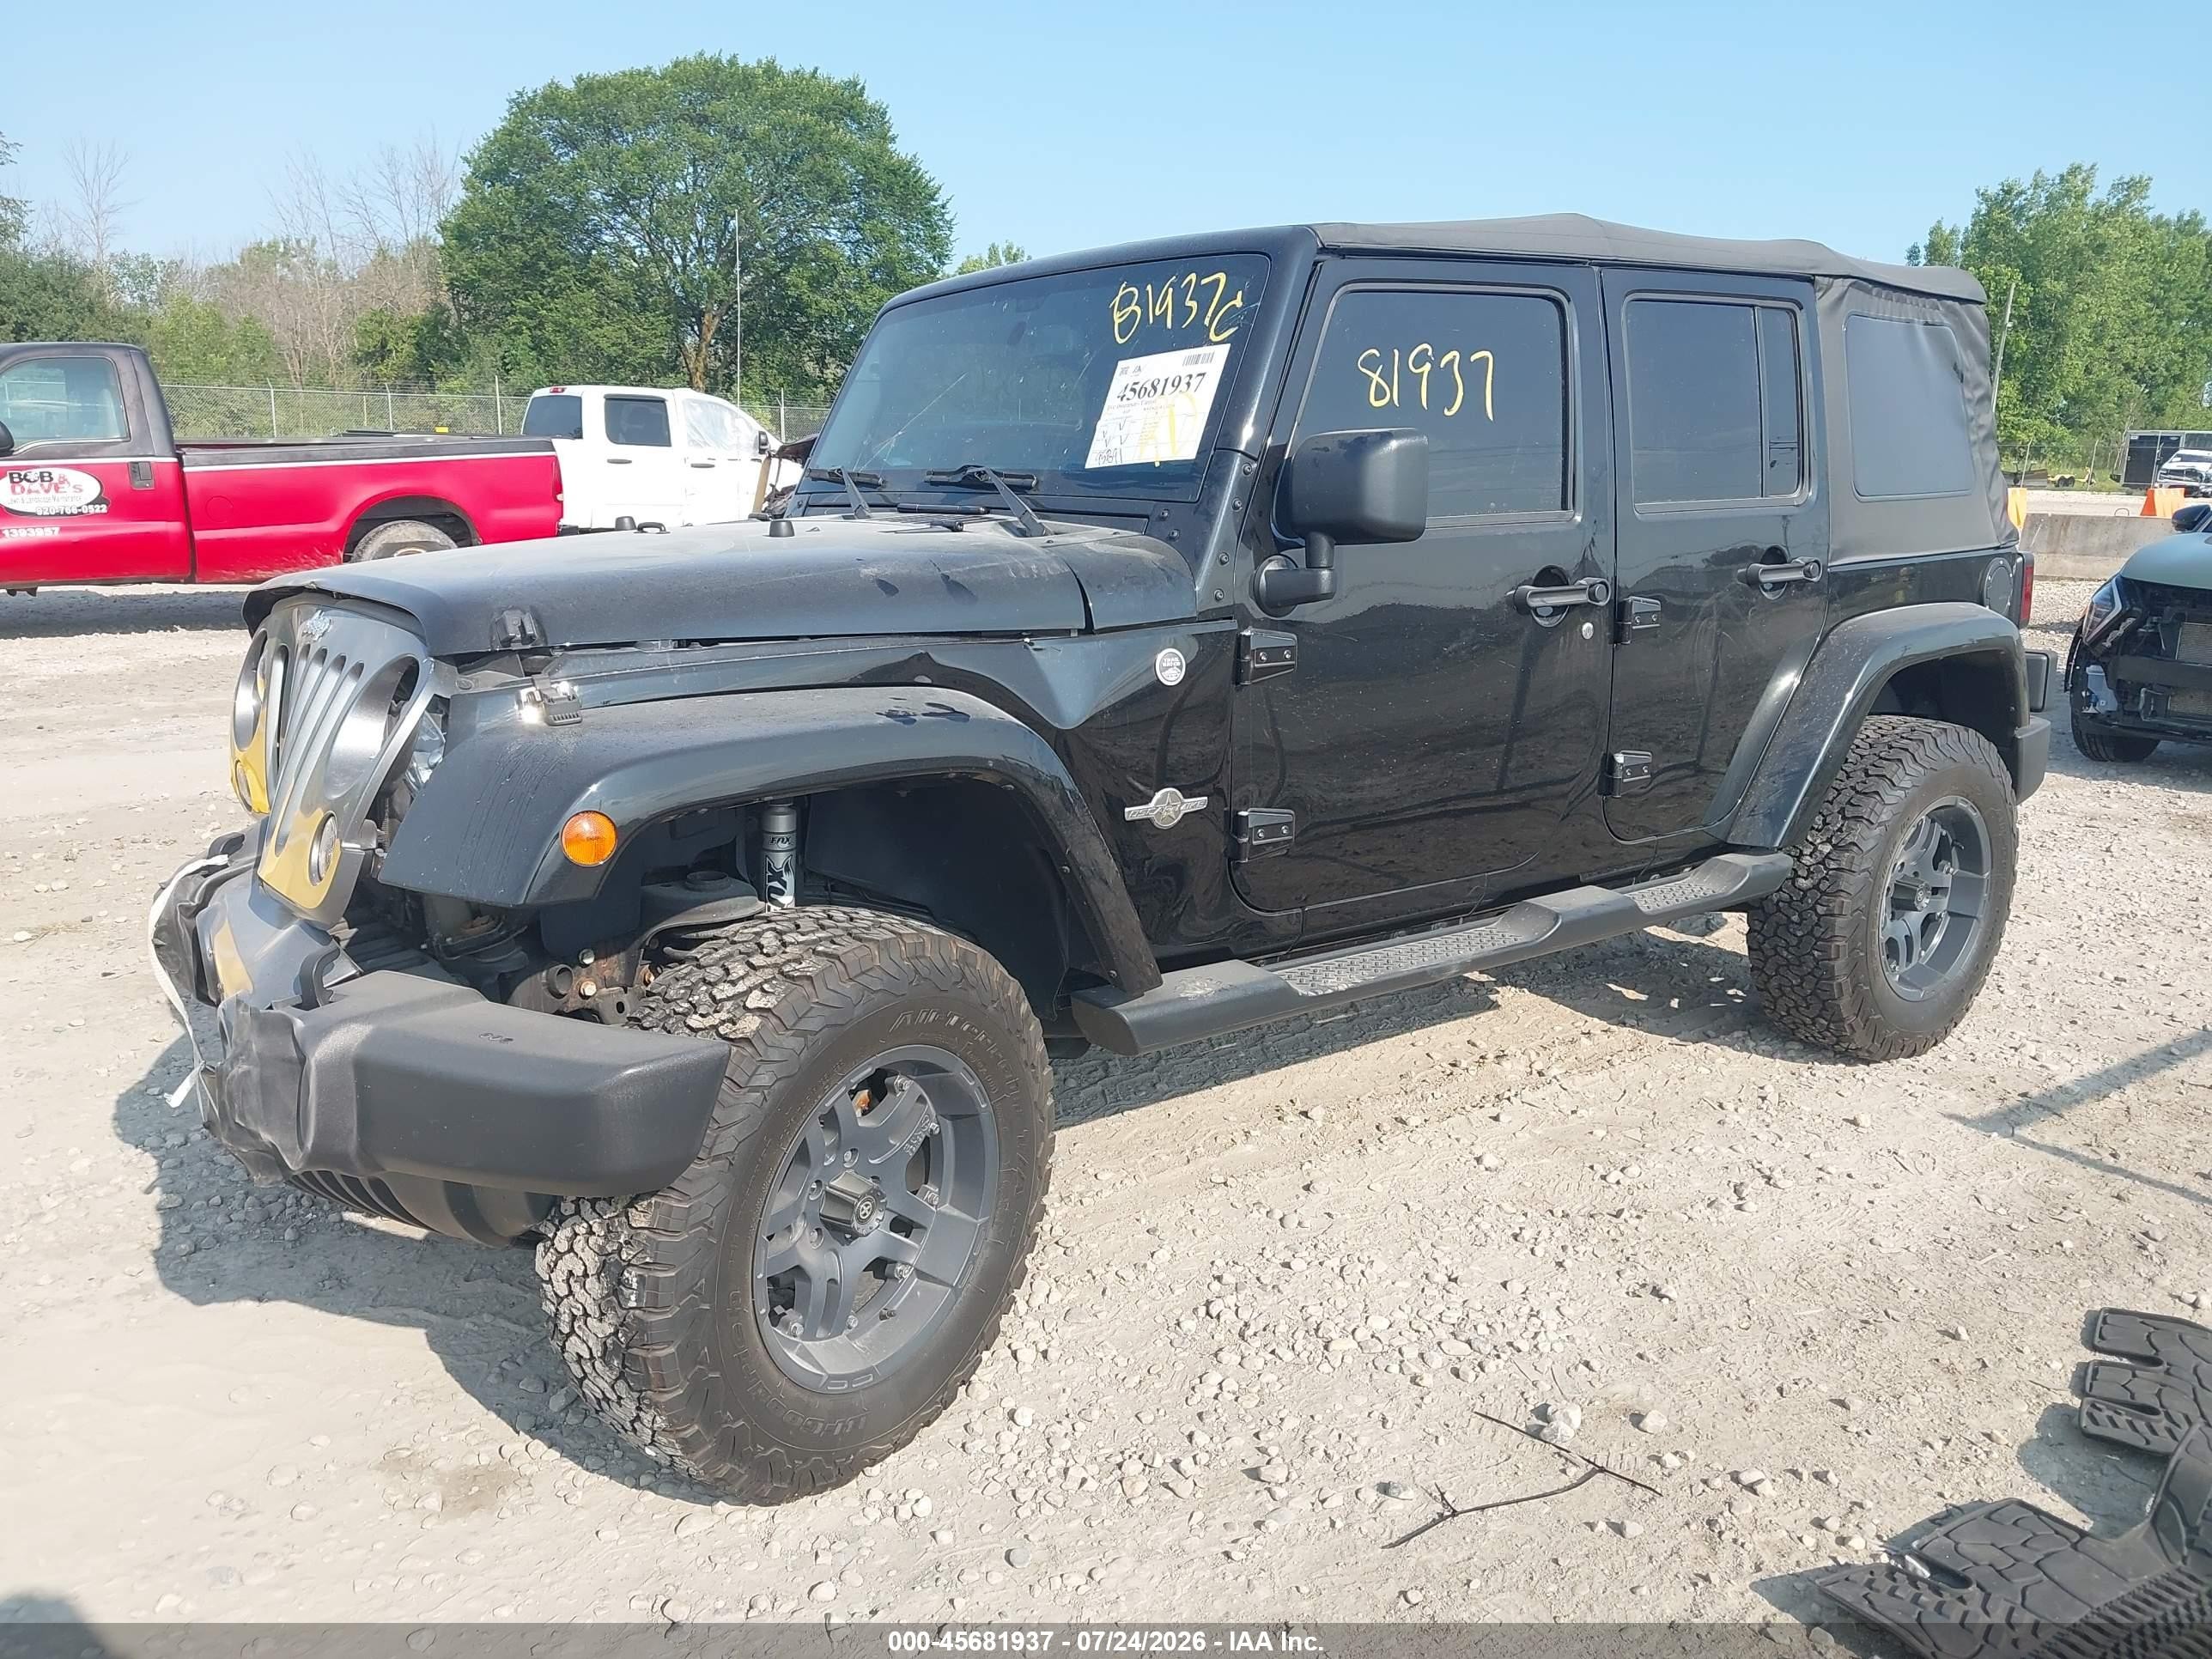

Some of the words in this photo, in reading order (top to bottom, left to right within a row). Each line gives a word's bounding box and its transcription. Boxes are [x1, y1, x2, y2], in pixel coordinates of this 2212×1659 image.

[1117, 372, 1207, 401] 45681937
[1357, 343, 1494, 421] 81937
[769, 836, 792, 846] FOX
